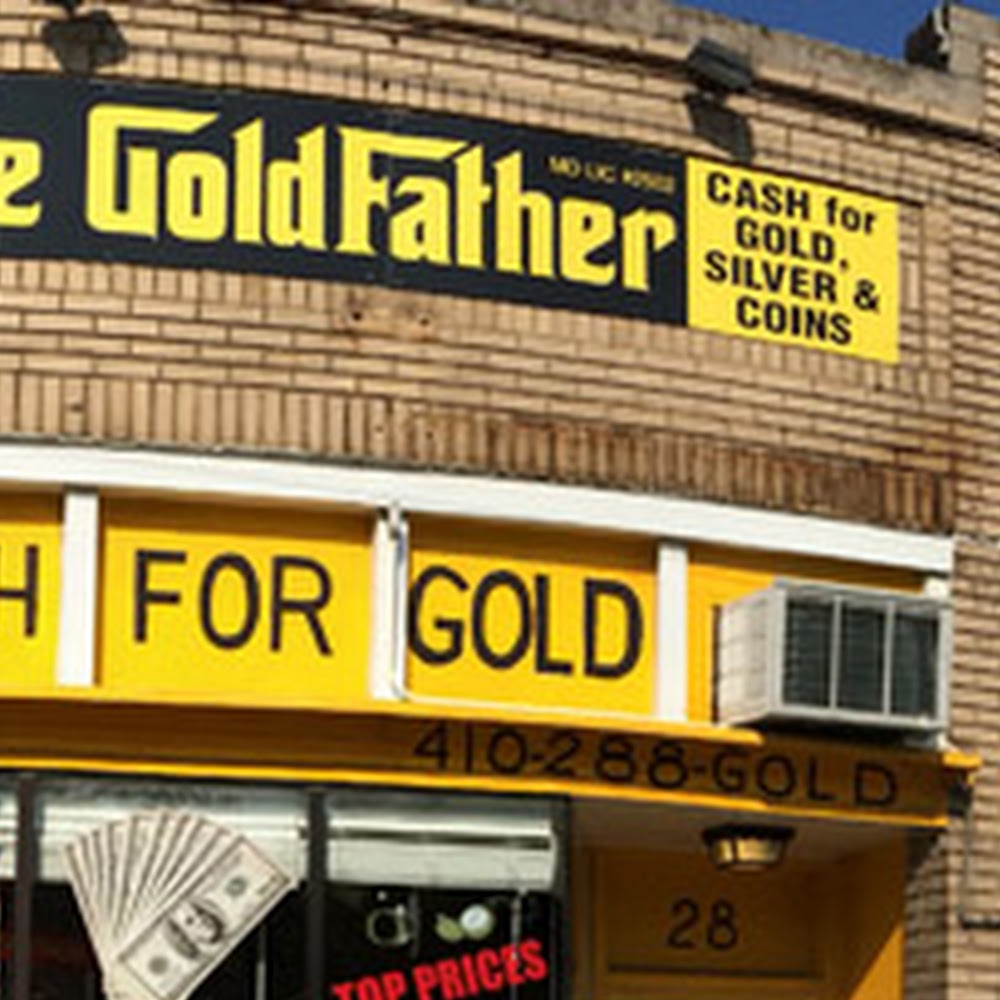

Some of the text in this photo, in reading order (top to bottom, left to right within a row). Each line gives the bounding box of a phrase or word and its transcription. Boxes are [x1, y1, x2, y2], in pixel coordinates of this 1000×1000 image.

[86, 104, 677, 292] GoldFather
[706, 171, 810, 222] CASH
[825, 195, 876, 236] for
[703, 249, 880, 315] SILVER &
[736, 295, 853, 346] COINS
[132, 548, 334, 657] FOR
[407, 565, 645, 680] GOLD
[413, 723, 899, 807] 410-288-GOLD
[665, 898, 740, 952] 28
